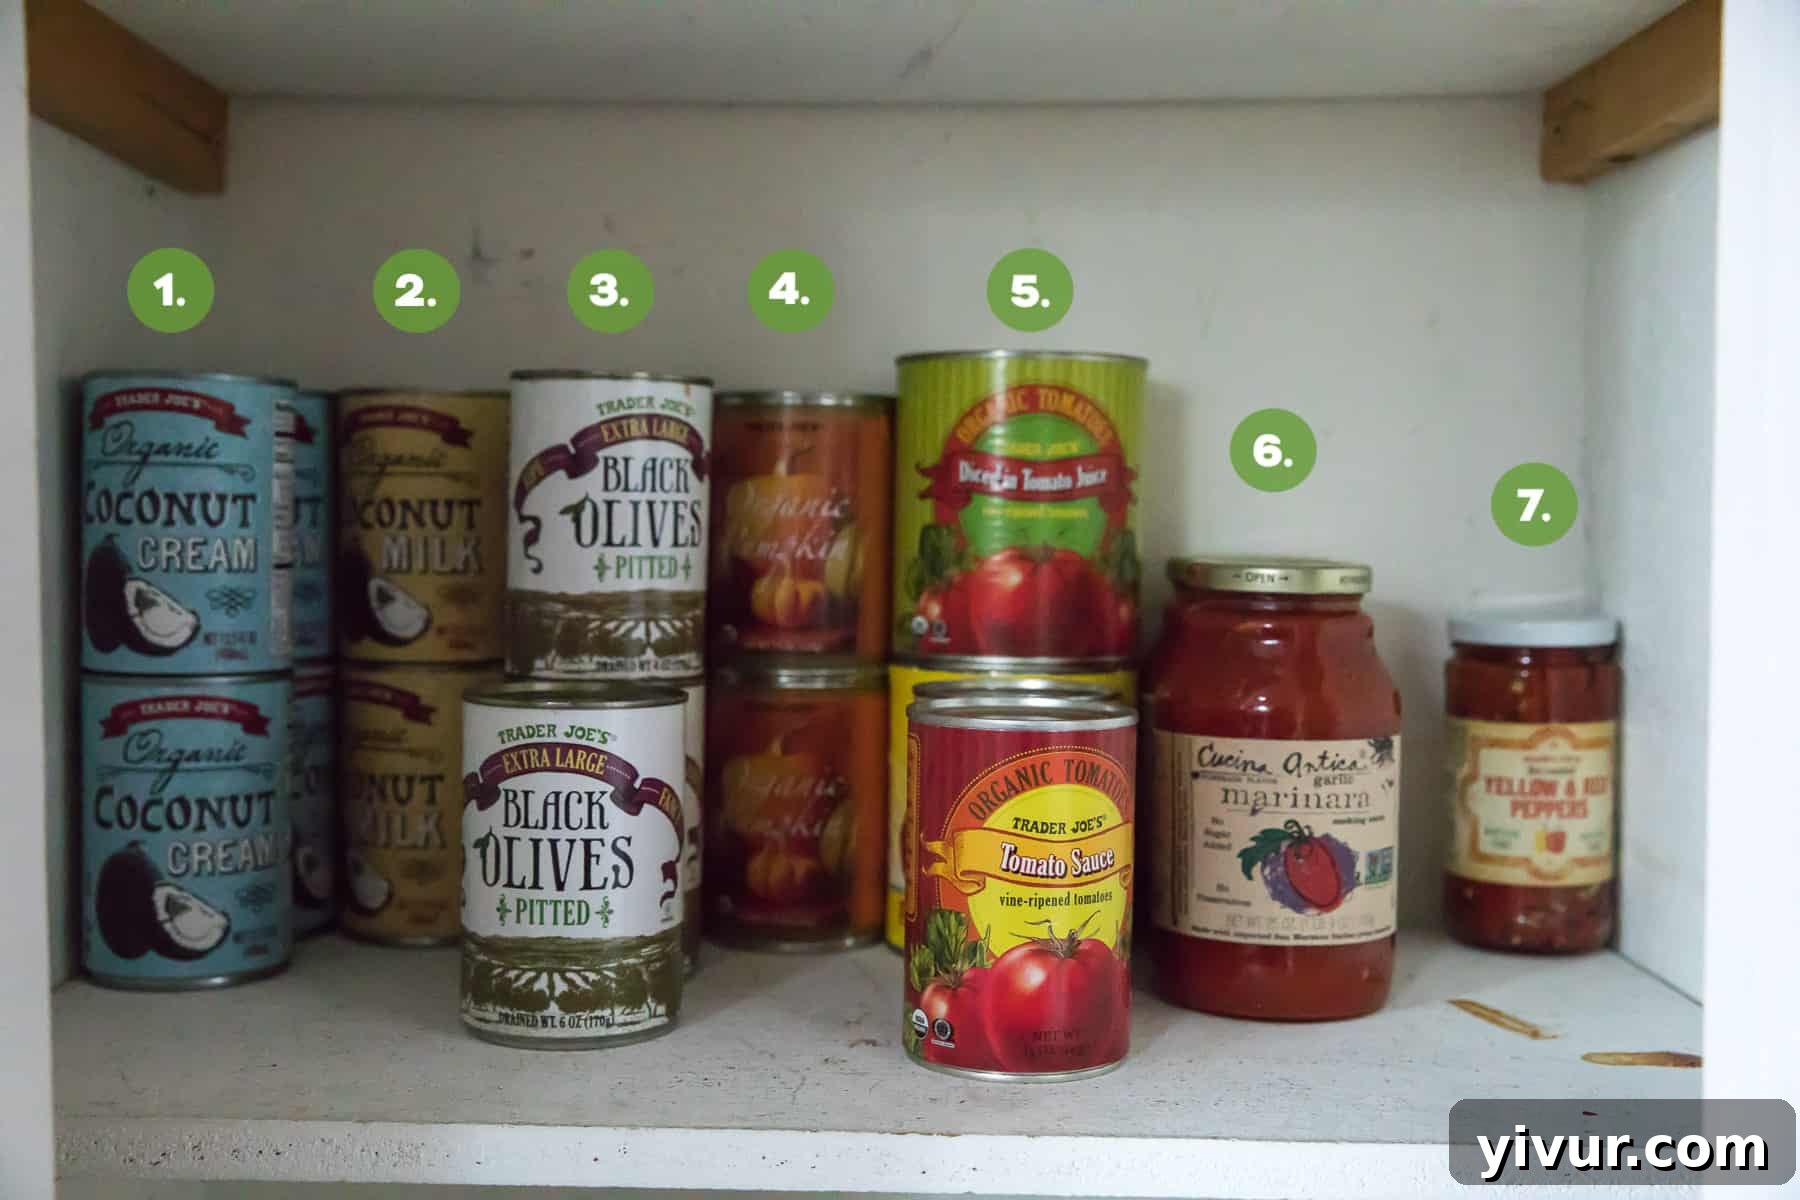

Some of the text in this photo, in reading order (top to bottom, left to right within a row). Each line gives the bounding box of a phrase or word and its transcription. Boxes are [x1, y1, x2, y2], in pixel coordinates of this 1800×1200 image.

[600, 417, 649, 443] EXTRA
[101, 420, 219, 485] Organic
[602, 456, 691, 494] BLACK
[1023, 467, 1073, 491] Tomato
[83, 481, 257, 529] COCONUT
[353, 498, 482, 531] CONUT
[572, 495, 701, 548] OLIVES
[137, 535, 257, 574] CREAM
[382, 532, 486, 575] MILK
[615, 554, 679, 580] PITTED
[497, 723, 611, 746] TRADER JOE'S
[122, 728, 248, 795] Organic
[502, 748, 551, 775] EXTRA
[554, 747, 608, 776] LARGE
[1197, 741, 1368, 778] Cucina Antica
[967, 760, 1055, 822] ORGANIC
[1220, 784, 1370, 809] marinara
[1484, 775, 1558, 797] YELLOW
[94, 784, 275, 833] COCONUT
[502, 789, 609, 831] BLACK
[1012, 816, 1103, 836] TRADER JOE'S
[1509, 799, 1588, 819] PEPPERS
[478, 832, 635, 891] OLIVES
[1000, 841, 1115, 879] Tomato Sauce
[515, 898, 591, 926] PITTED
[999, 890, 1113, 909] vine-ripened tomatoes
